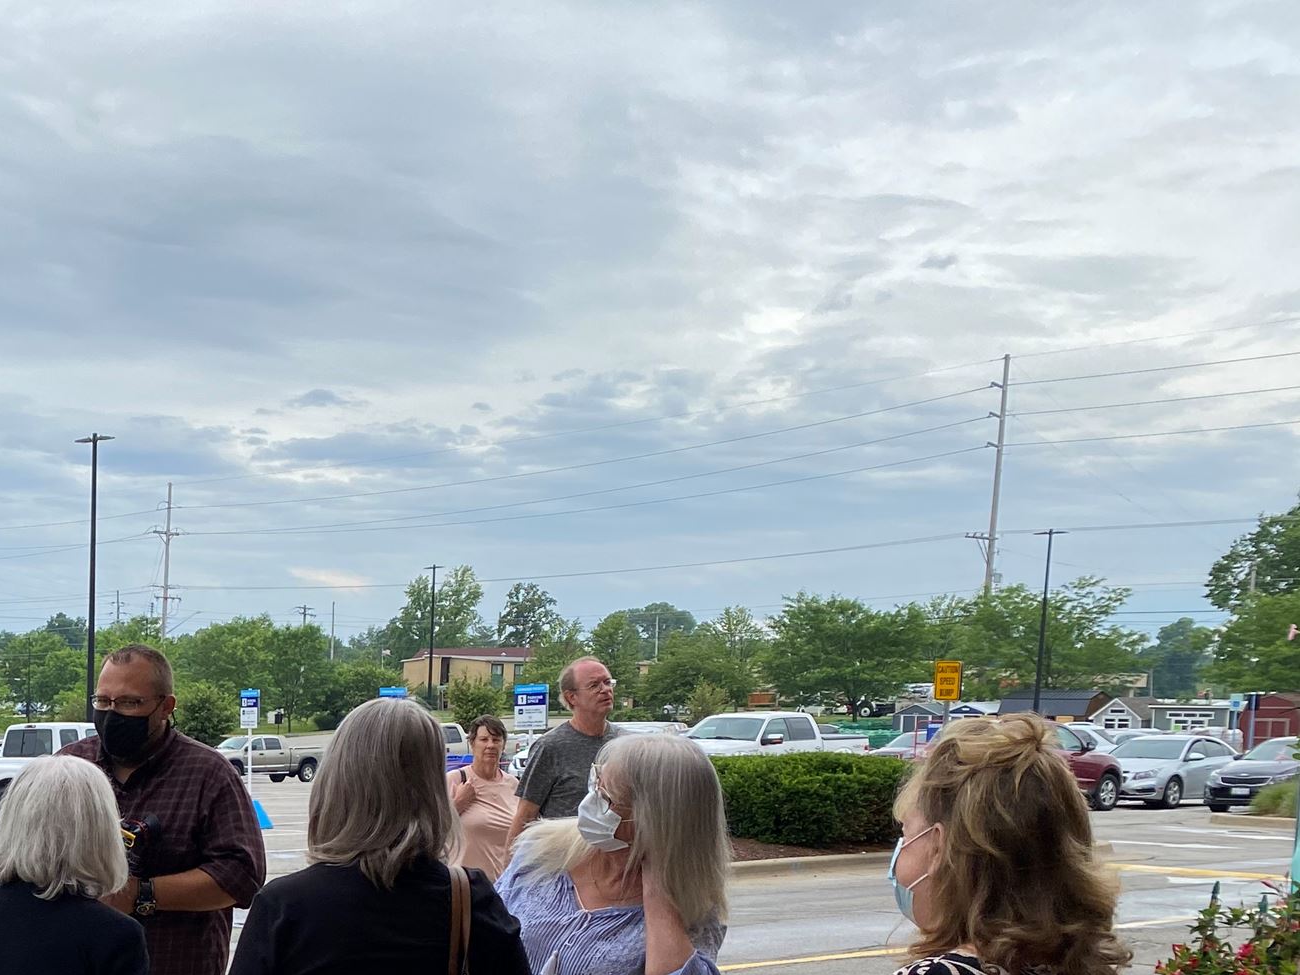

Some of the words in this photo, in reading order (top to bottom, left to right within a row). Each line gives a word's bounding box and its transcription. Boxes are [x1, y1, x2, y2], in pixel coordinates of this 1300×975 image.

[937, 665, 958, 673] CAUTION
[939, 677, 956, 685] SPEED
[939, 688, 955, 696] BUMP
